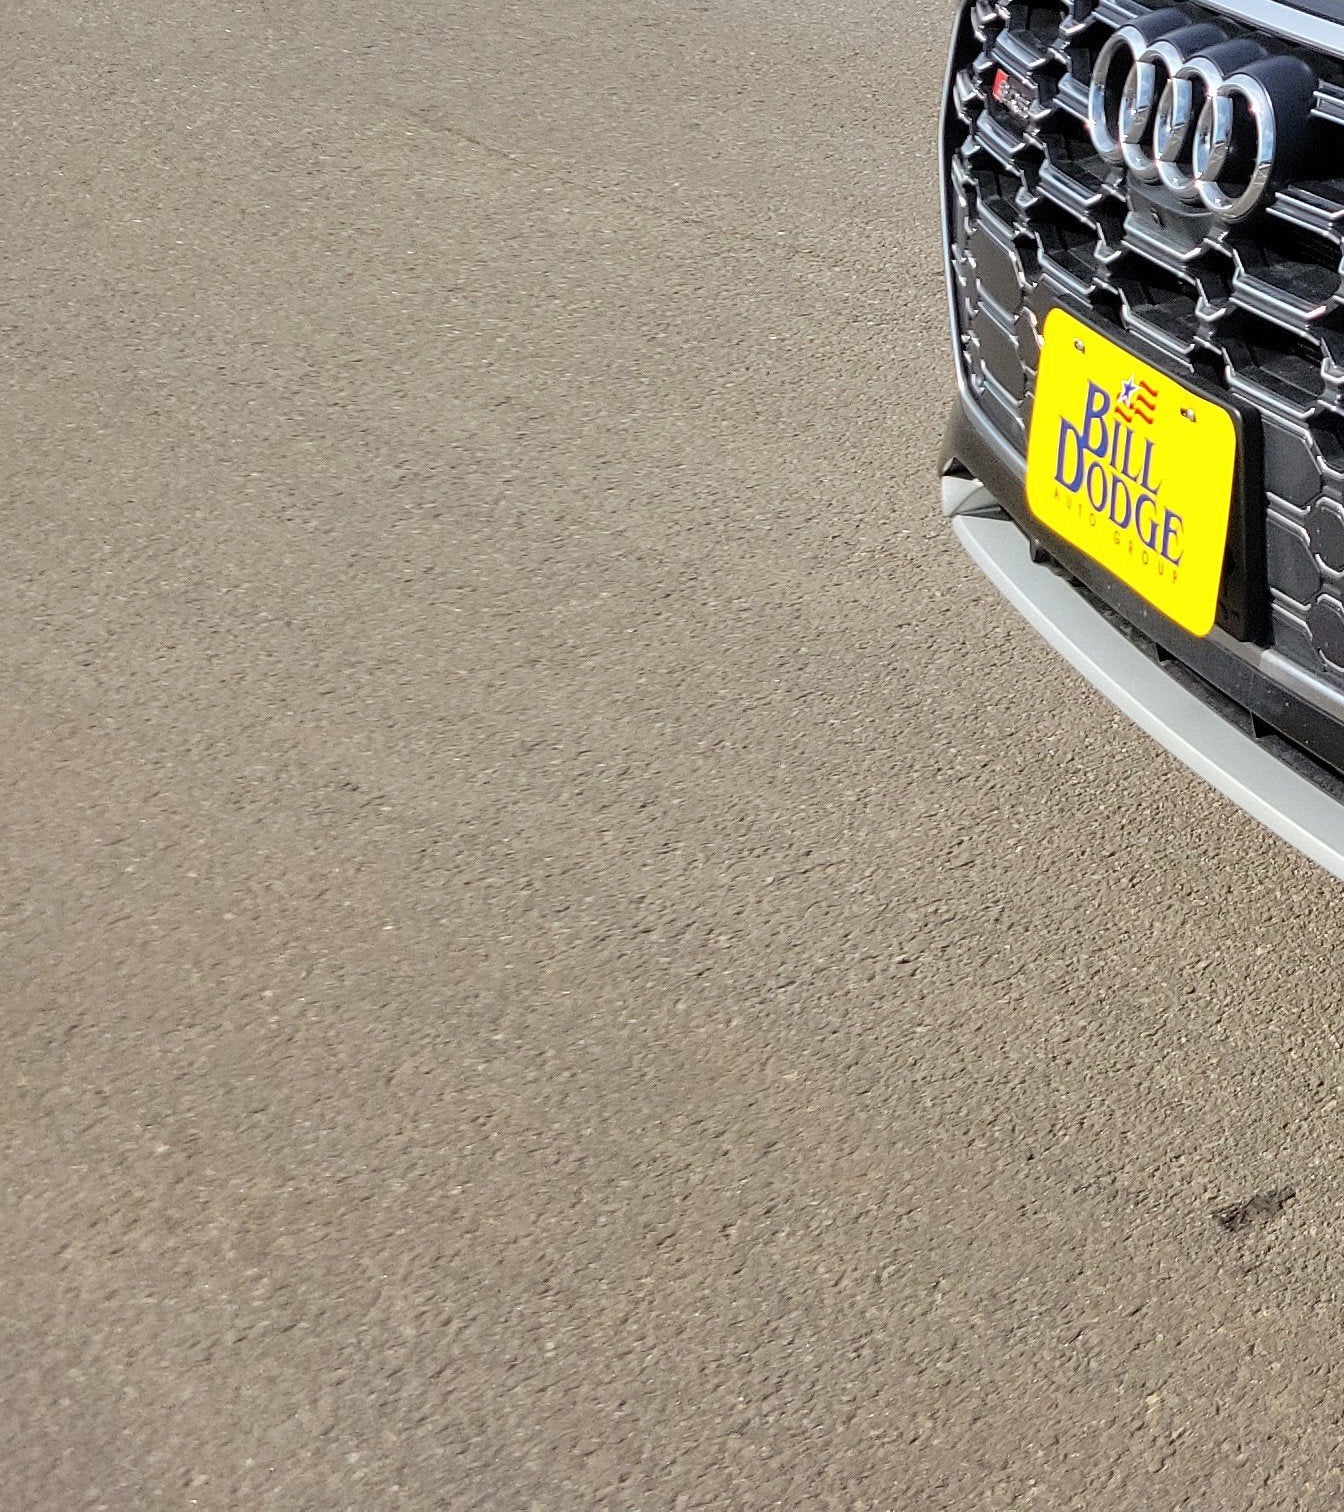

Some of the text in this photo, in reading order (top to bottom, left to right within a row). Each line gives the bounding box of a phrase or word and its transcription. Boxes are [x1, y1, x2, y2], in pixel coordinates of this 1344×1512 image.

[1054, 415, 1184, 567] DODGE
[1083, 378, 1162, 495] BILL
[1053, 487, 1179, 584] AUTO GROUP
